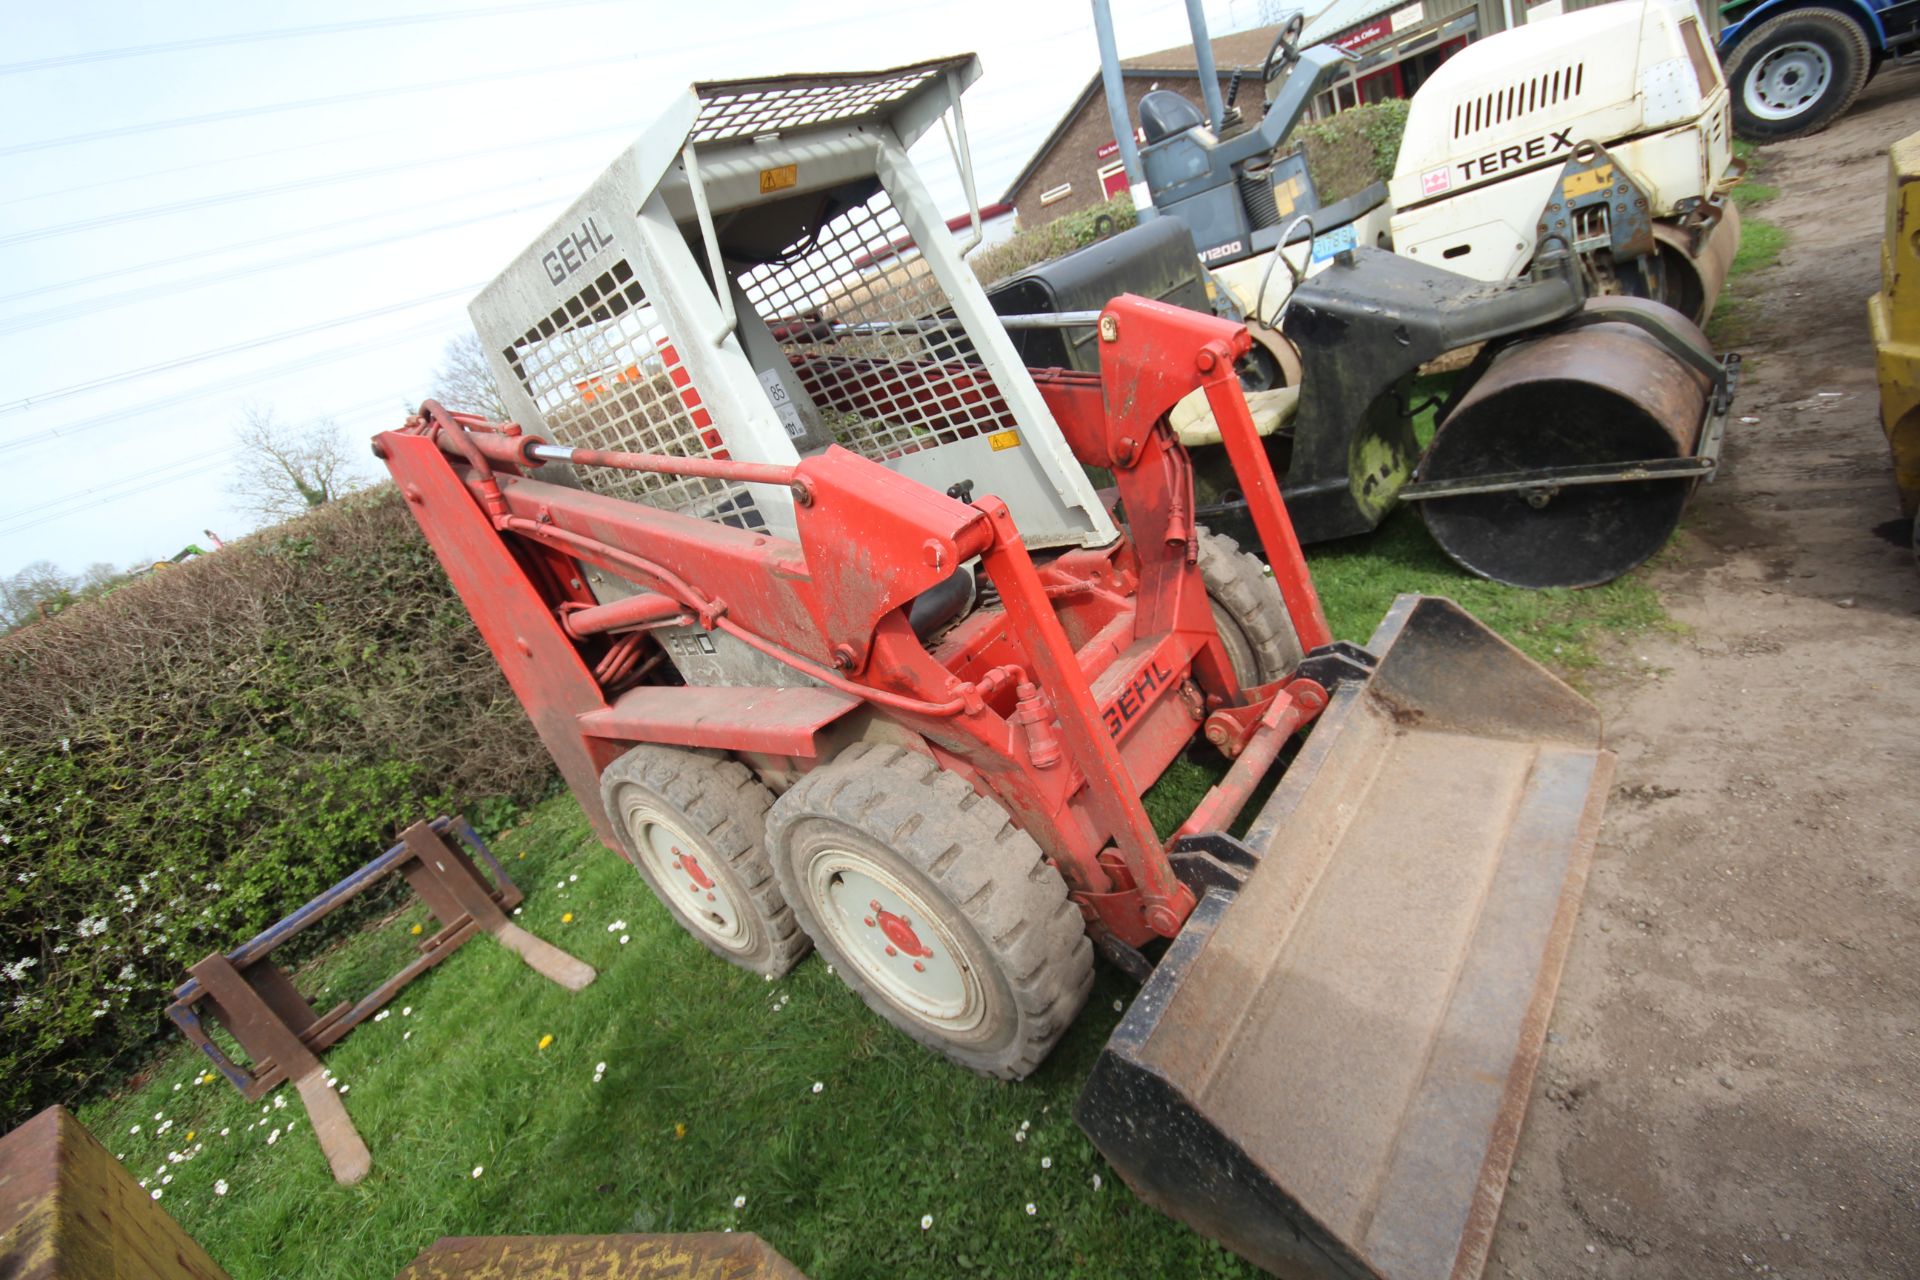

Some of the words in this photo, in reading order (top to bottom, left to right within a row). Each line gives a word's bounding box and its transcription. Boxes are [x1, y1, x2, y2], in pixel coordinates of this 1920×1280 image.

[1457, 126, 1574, 180] TEREX
[542, 216, 614, 287] GEHL
[770, 383, 785, 401] 85
[1099, 661, 1173, 739] GEHL
